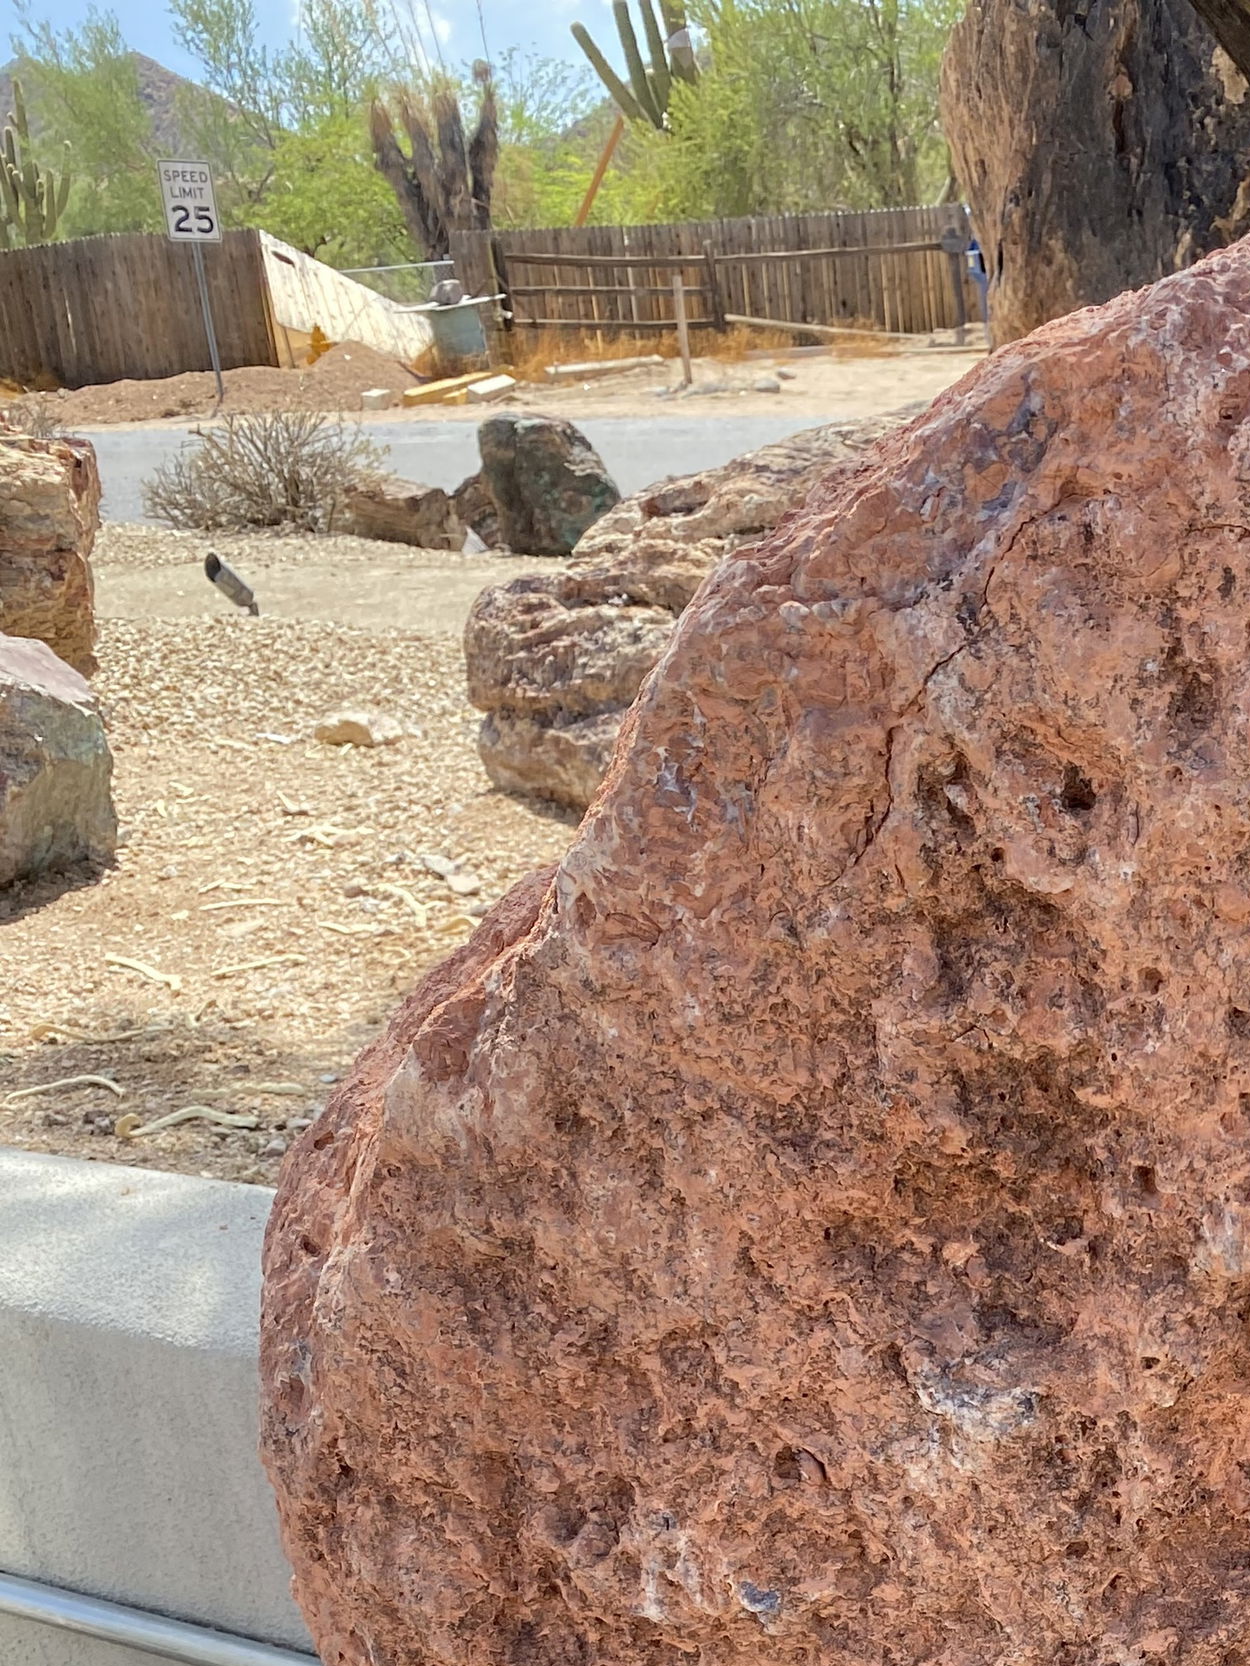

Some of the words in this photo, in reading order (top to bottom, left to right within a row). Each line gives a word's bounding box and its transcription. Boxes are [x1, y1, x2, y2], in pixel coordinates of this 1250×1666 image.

[163, 170, 208, 183] SPEED
[170, 187, 204, 199] LIMIT
[172, 205, 214, 233] 25
